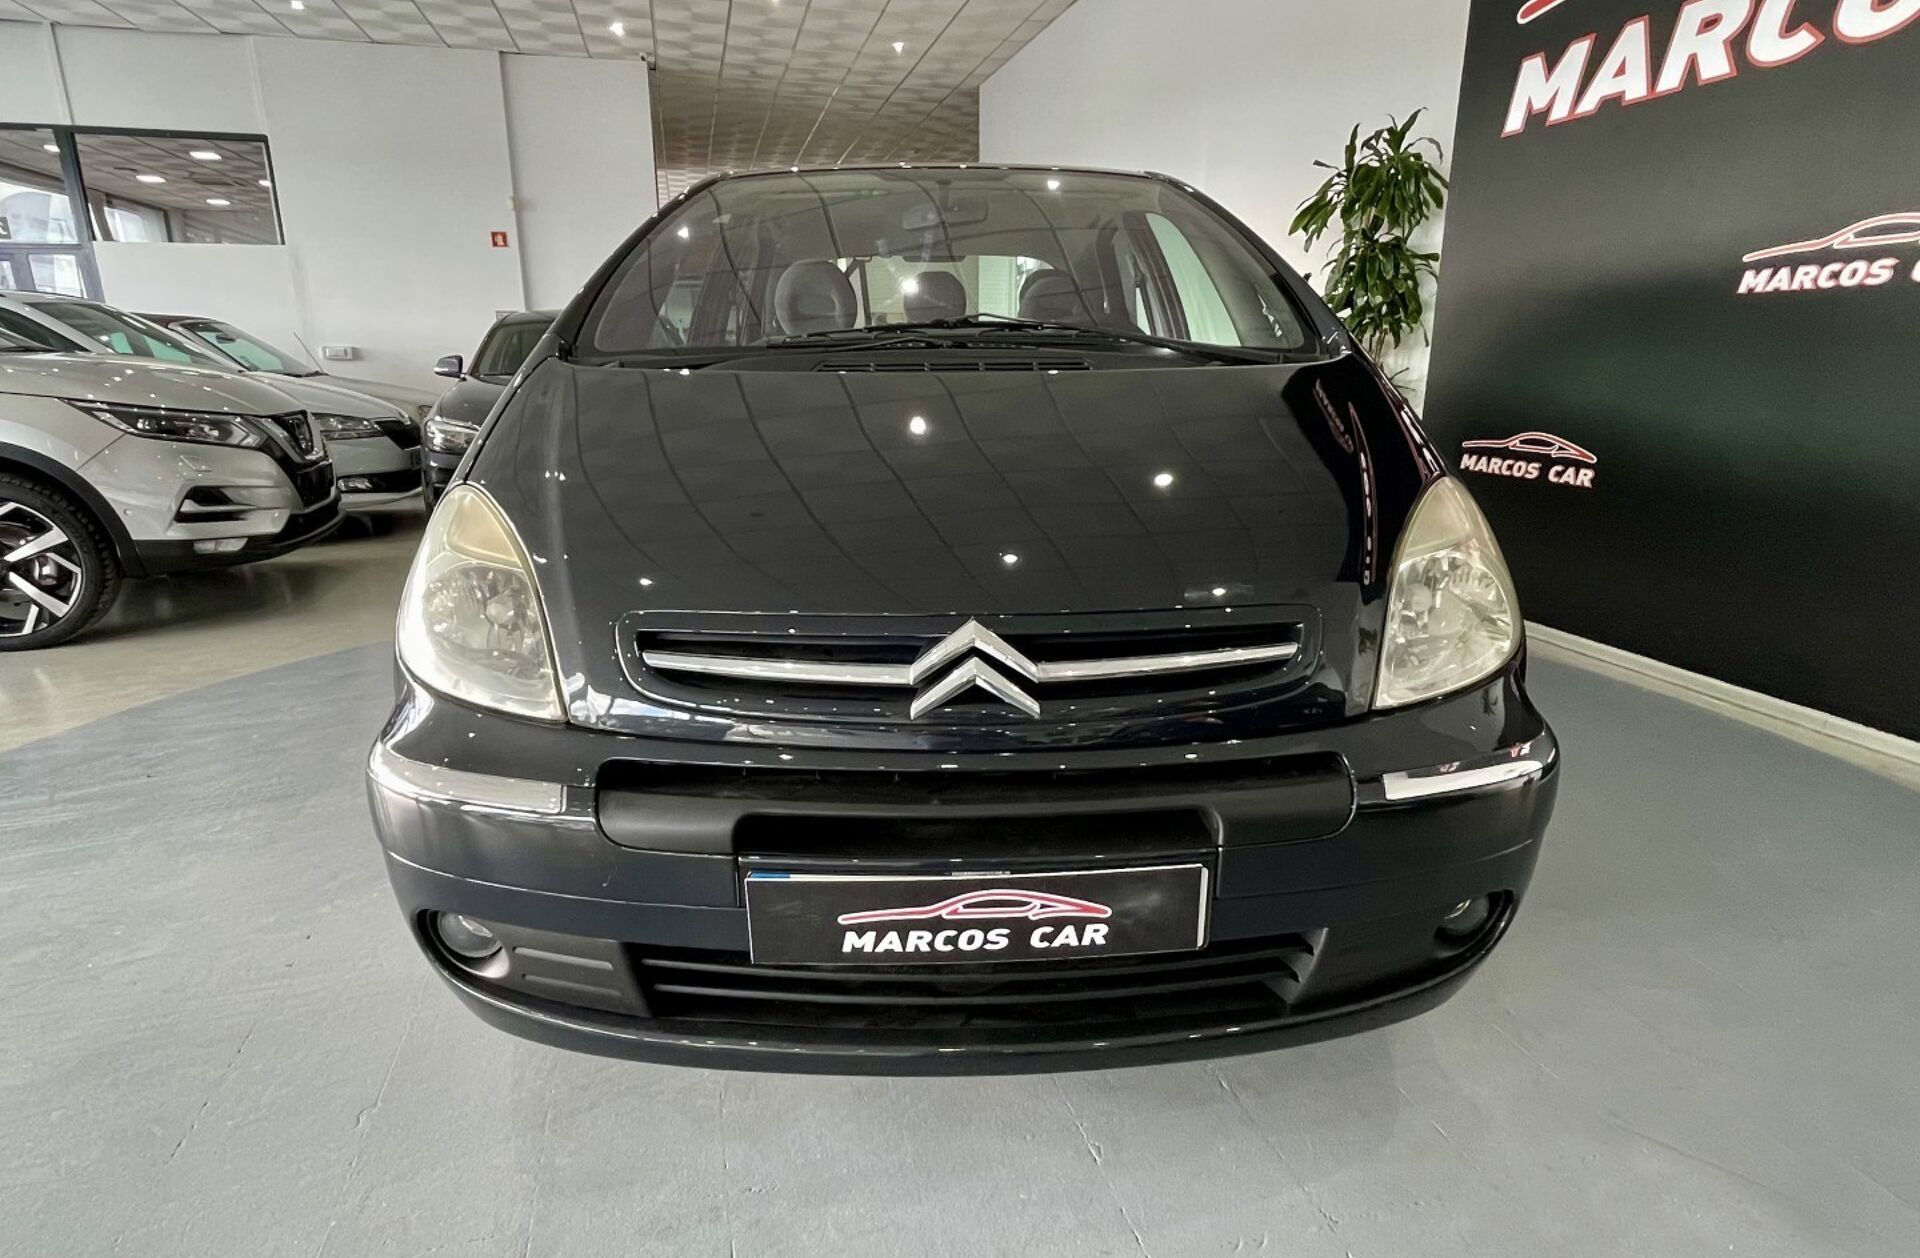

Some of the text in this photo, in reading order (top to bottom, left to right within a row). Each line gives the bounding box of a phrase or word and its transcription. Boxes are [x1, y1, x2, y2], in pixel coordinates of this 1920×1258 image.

[1736, 257, 1900, 294] MARCOS
[1460, 453, 1595, 488] MARCOS CAR
[842, 923, 1109, 952] MARCOS CAR
